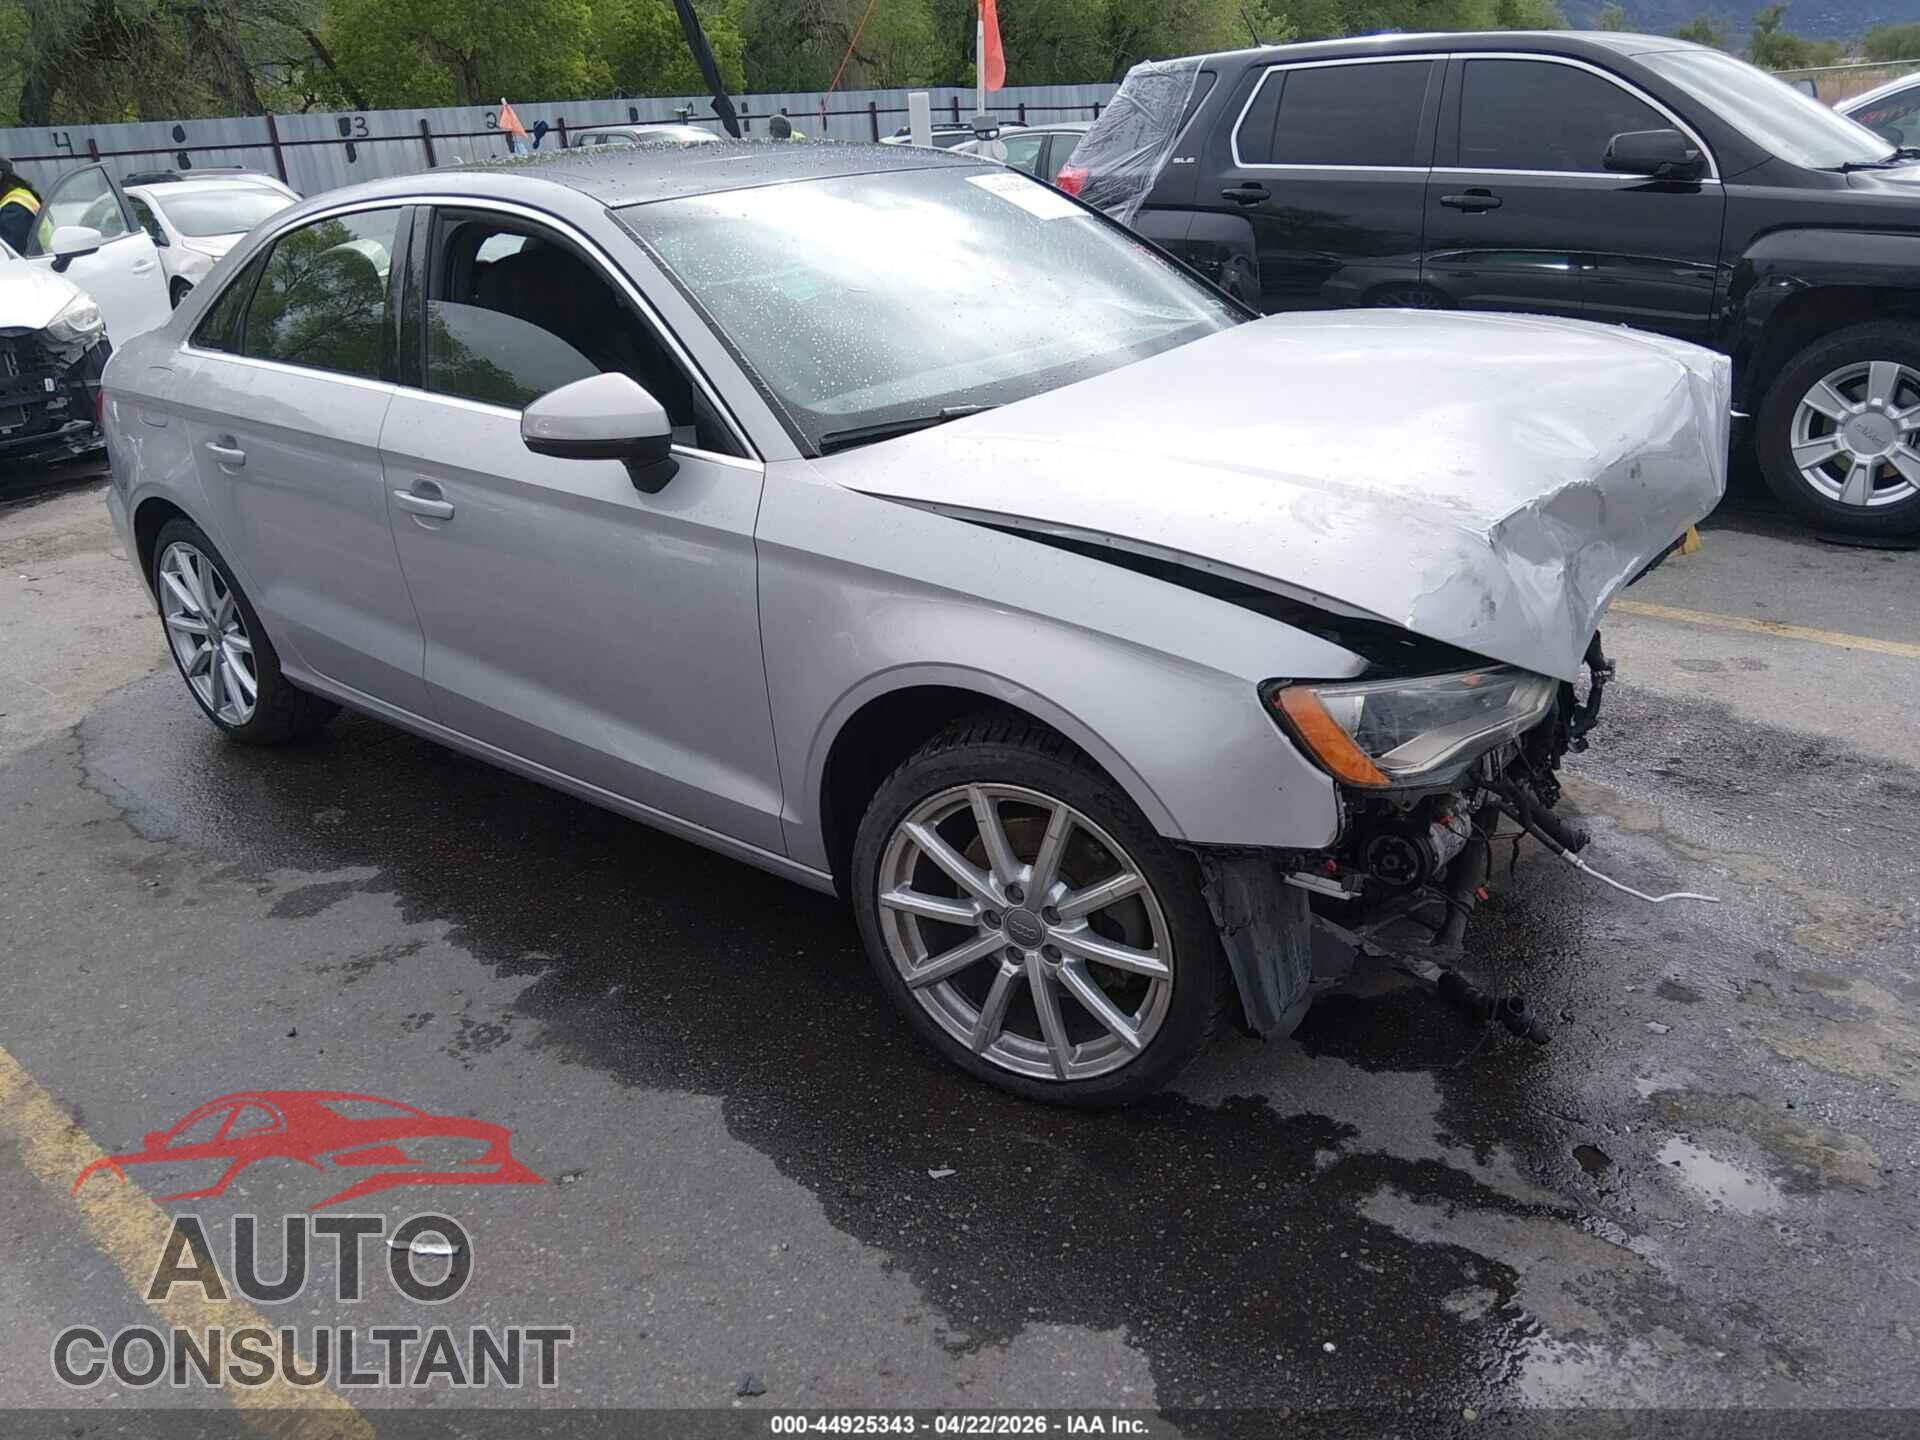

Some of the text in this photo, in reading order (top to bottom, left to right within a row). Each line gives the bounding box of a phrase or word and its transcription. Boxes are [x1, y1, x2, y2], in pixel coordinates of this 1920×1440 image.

[354, 116, 369, 138] 3
[485, 112, 500, 130] 2
[52, 131, 74, 157] 4
